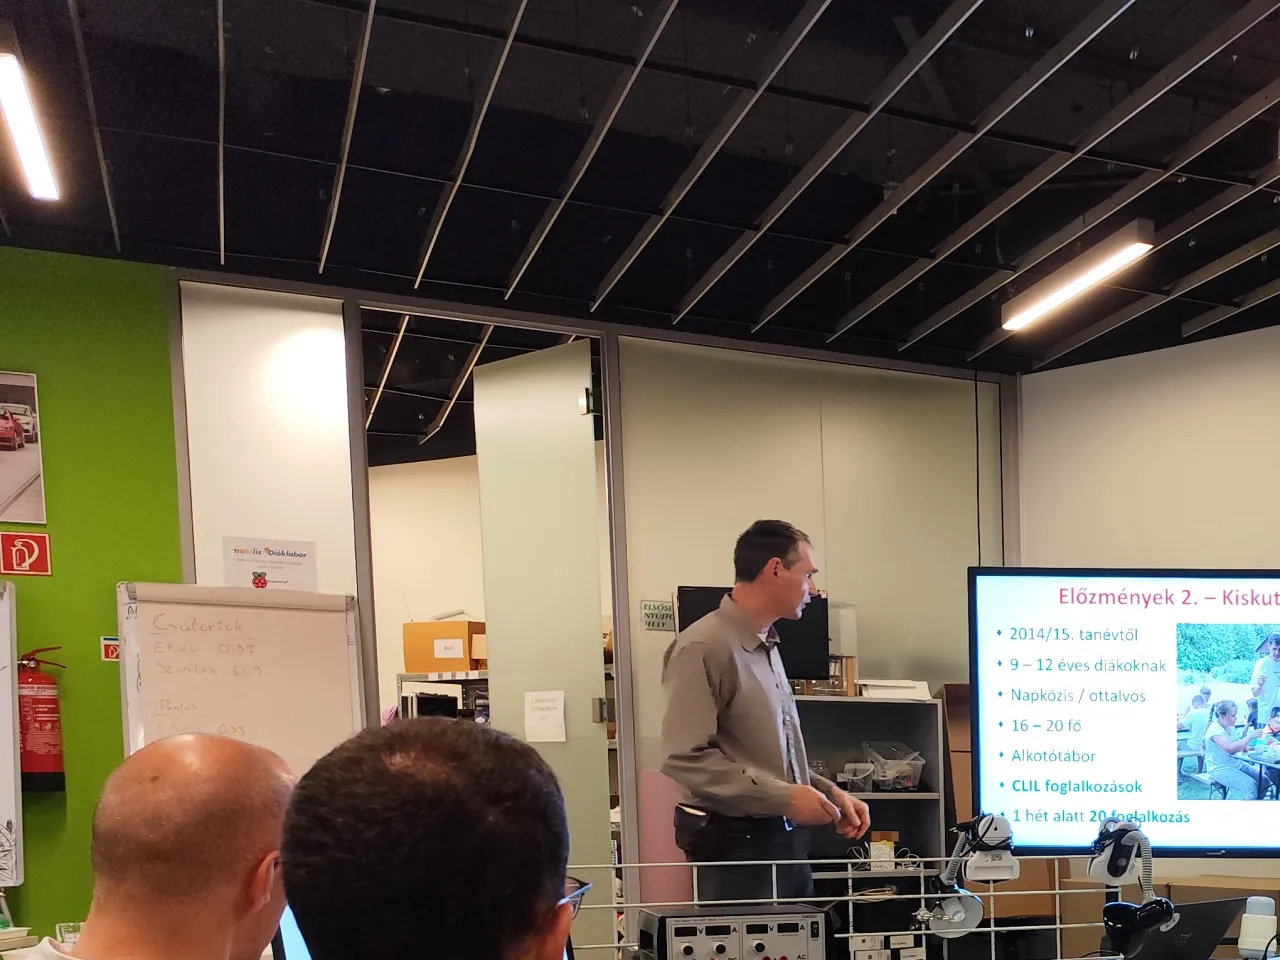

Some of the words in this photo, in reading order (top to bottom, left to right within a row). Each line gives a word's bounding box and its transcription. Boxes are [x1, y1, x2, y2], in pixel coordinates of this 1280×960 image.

[1059, 588, 1175, 609] Előzmények
[1181, 589, 1198, 605] 2.
[644, 620, 667, 628] HELY
[1010, 626, 1074, 642] 2014/15.
[1079, 627, 1138, 641] tanévtől
[1010, 658, 1019, 671] 9
[1037, 658, 1053, 671] 12
[1058, 658, 1090, 672] éves
[1094, 659, 1167, 672] diákoknak
[1011, 688, 1074, 704] Napközis
[1089, 690, 1146, 702] ottalvós
[1012, 719, 1028, 732] 16
[1046, 719, 1064, 732] 20
[1068, 719, 1082, 732] fő
[1011, 749, 1096, 763] Alkotótábor
[1012, 780, 1041, 792] CLIL
[1045, 780, 1143, 795] foglalkozások
[1013, 810, 1021, 822] 1
[1025, 809, 1048, 823] hét
[1053, 810, 1085, 823] alatt
[1089, 810, 1107, 823] 20
[1111, 810, 1190, 823] foglalkozás
